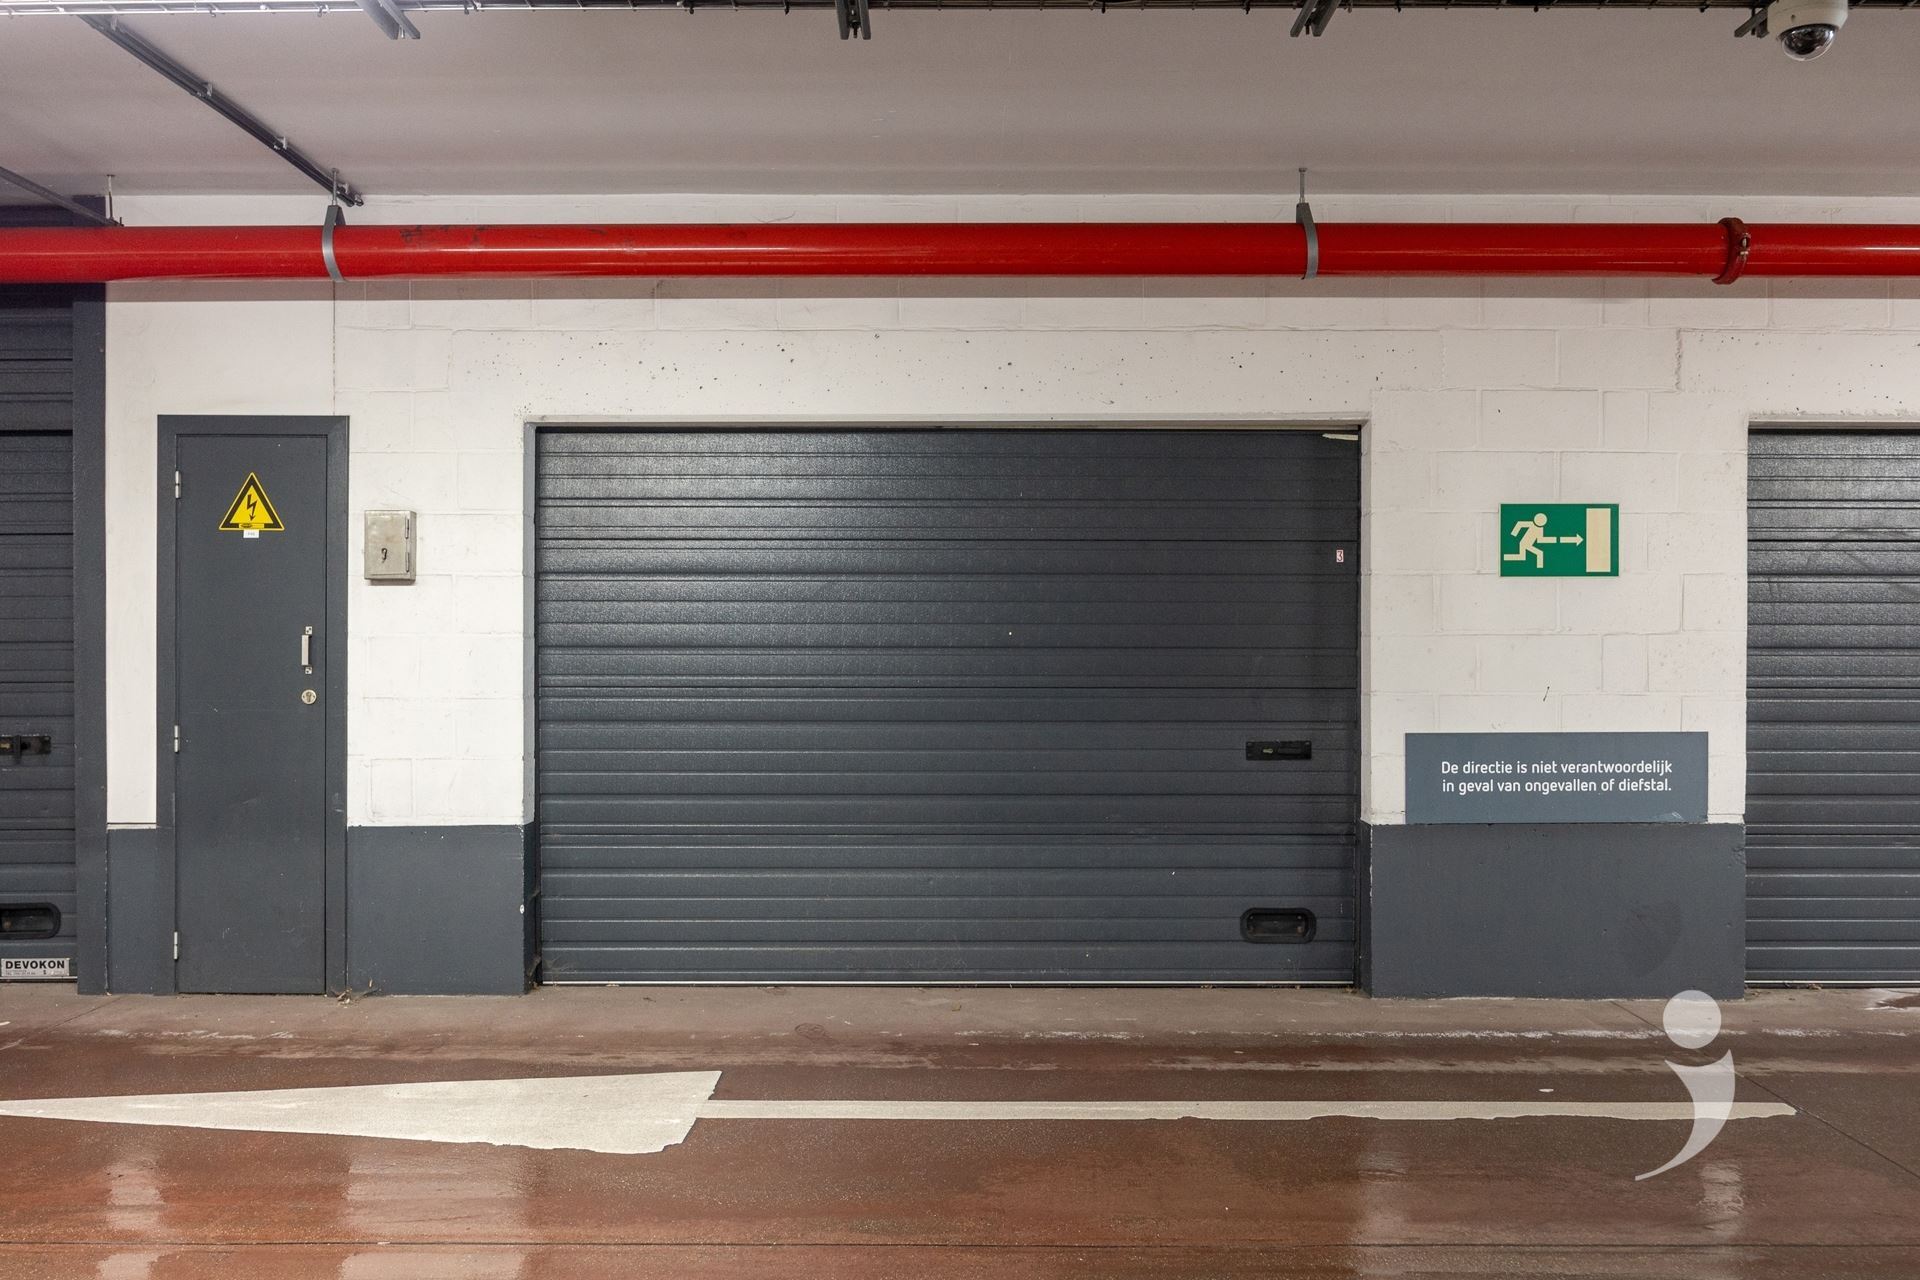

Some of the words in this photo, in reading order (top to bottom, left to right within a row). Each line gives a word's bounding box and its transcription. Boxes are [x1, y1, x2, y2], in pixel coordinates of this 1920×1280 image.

[1337, 550, 1343, 562] 3
[1441, 761, 1459, 774] De
[1462, 760, 1513, 774] directie
[1517, 760, 1528, 774] is
[1531, 760, 1558, 774] niet
[1561, 760, 1673, 777] verantwoordelijk
[1442, 779, 1455, 793] in
[1458, 779, 1494, 796] geval
[1497, 781, 1521, 792] van
[1525, 779, 1597, 796] ongevallen
[1601, 778, 1616, 792] of
[1618, 778, 1672, 792] diefstal.
[5, 960, 65, 970] DEVOKON
